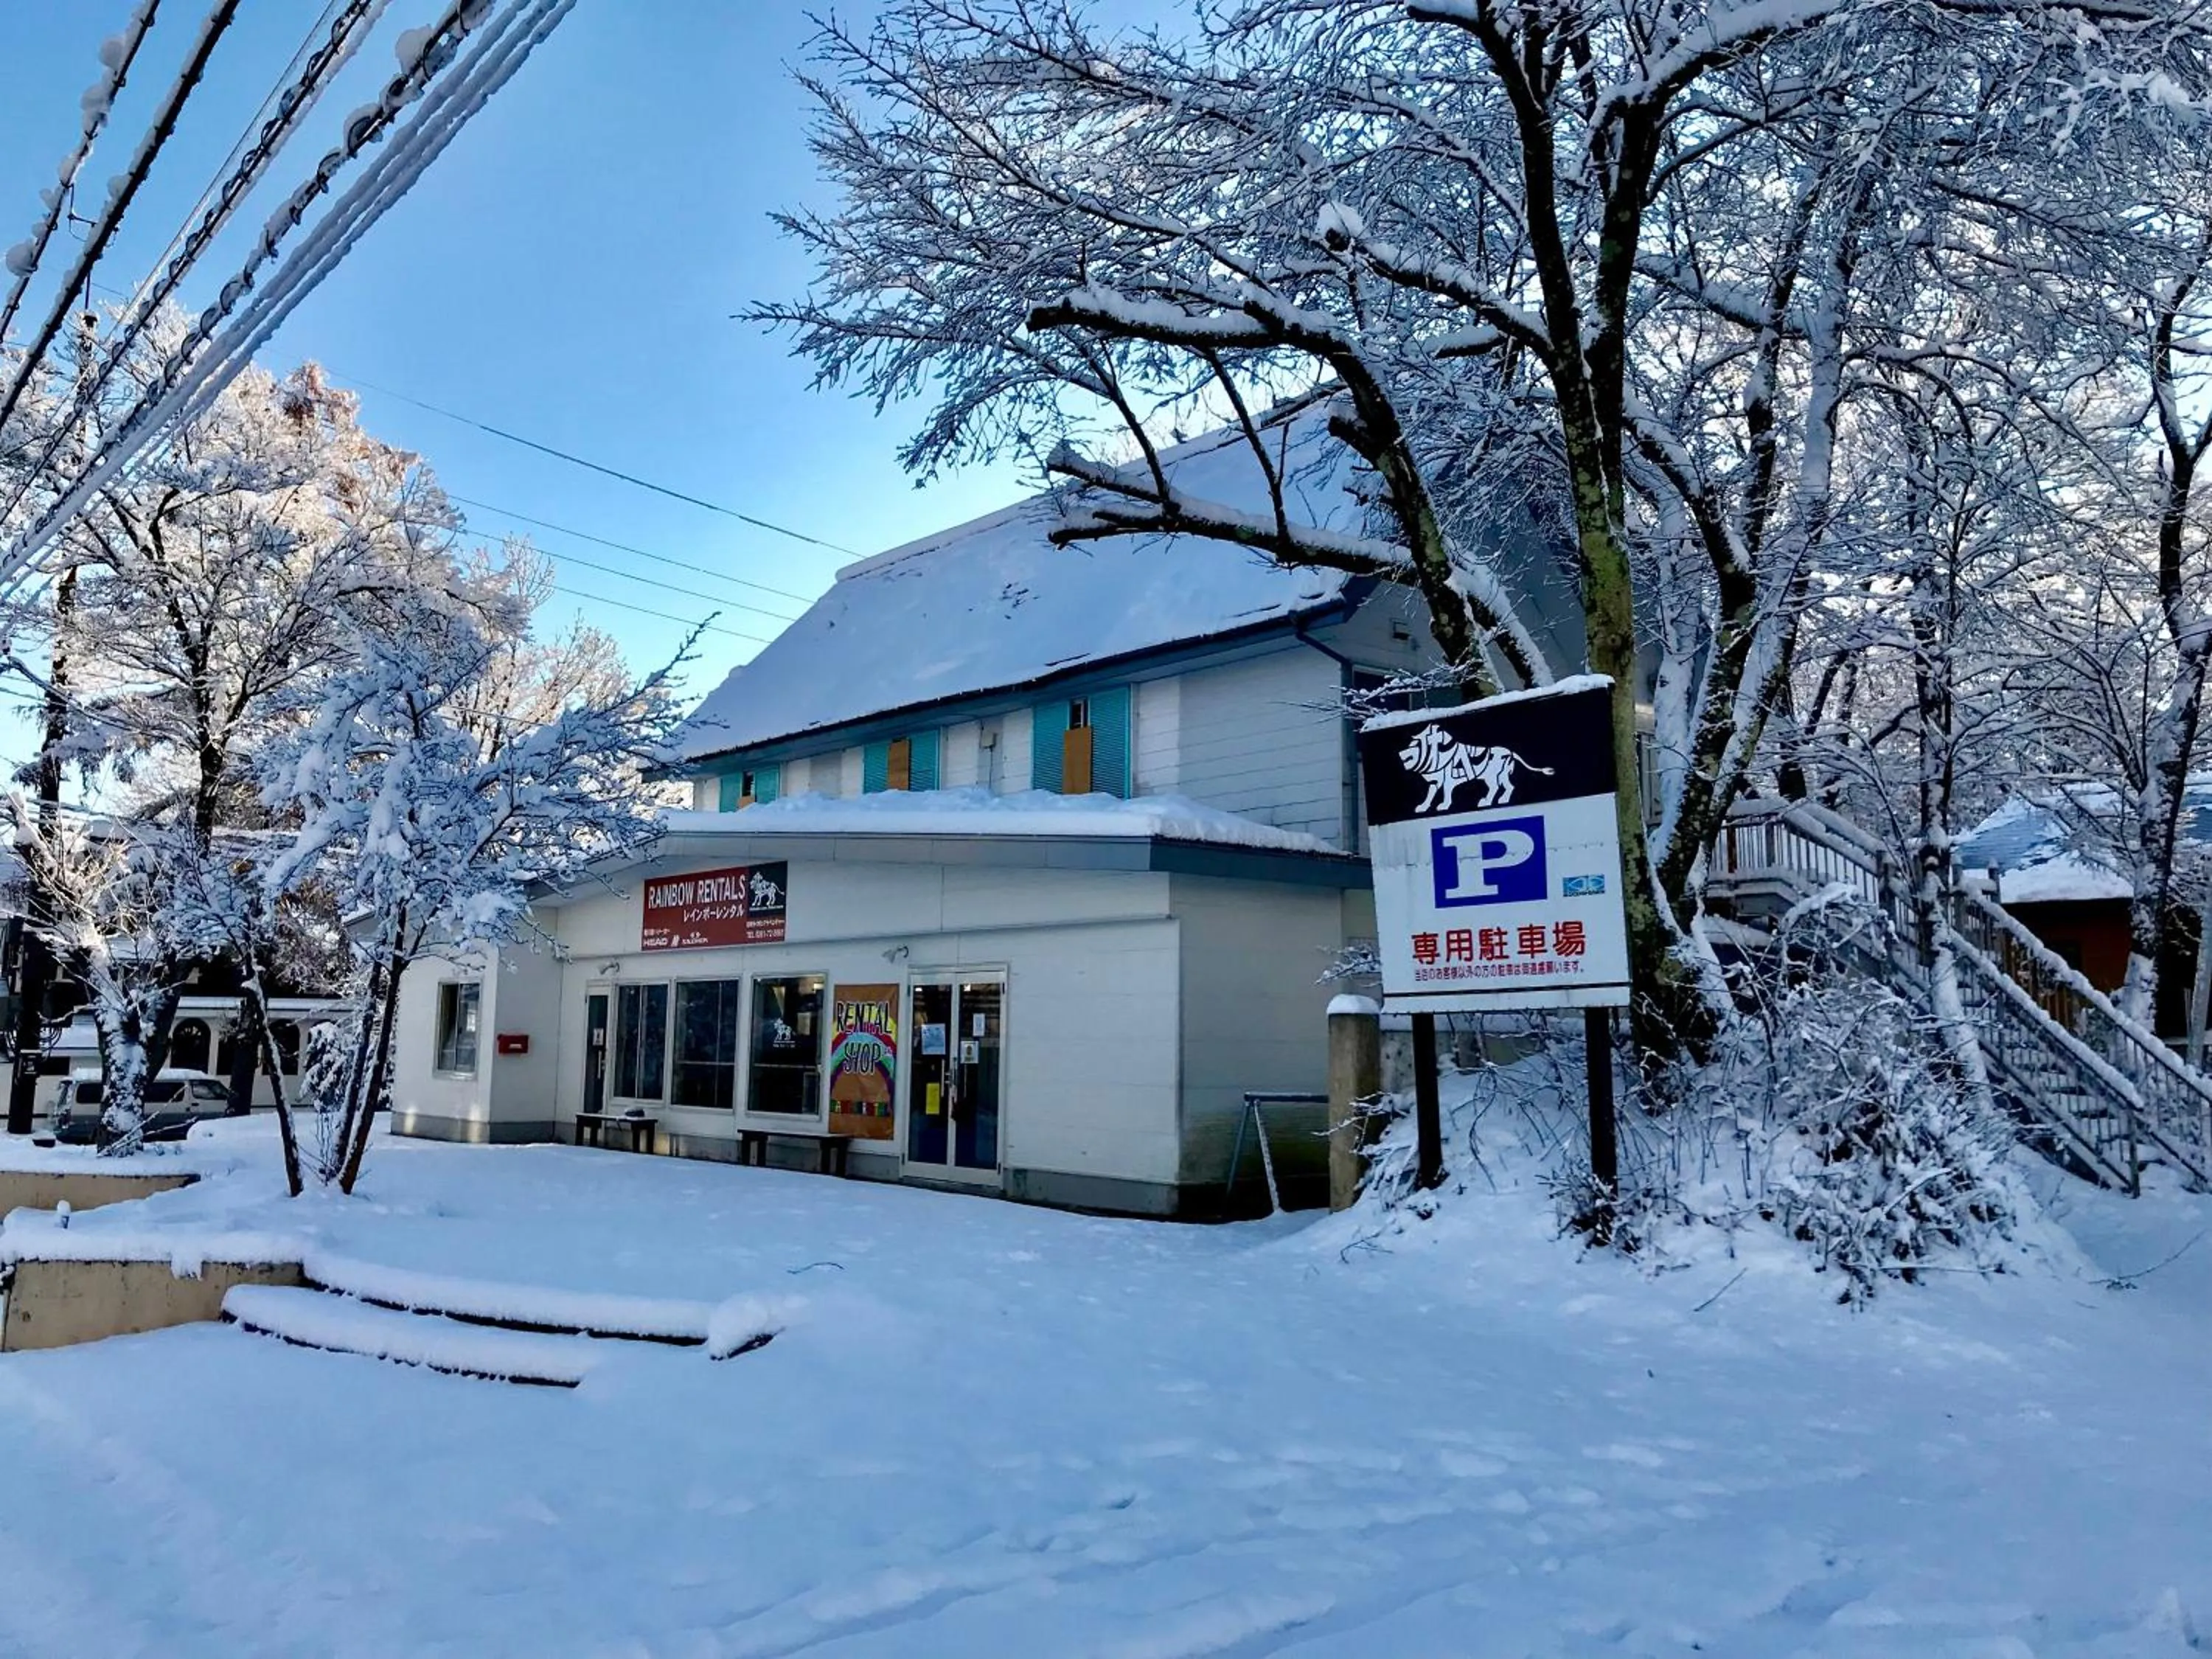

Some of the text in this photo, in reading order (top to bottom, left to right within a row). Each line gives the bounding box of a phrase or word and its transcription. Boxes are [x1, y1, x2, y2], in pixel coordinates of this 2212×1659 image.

[1443, 830, 1534, 899] P
[649, 874, 745, 908] RAINBOW RENTALS
[684, 904, 744, 922] レインボーレンタル
[644, 938, 668, 947] HEAD
[1411, 920, 1586, 964] 専用駐車場
[836, 1001, 891, 1034] RENTAL
[844, 1042, 881, 1074] SHOP
